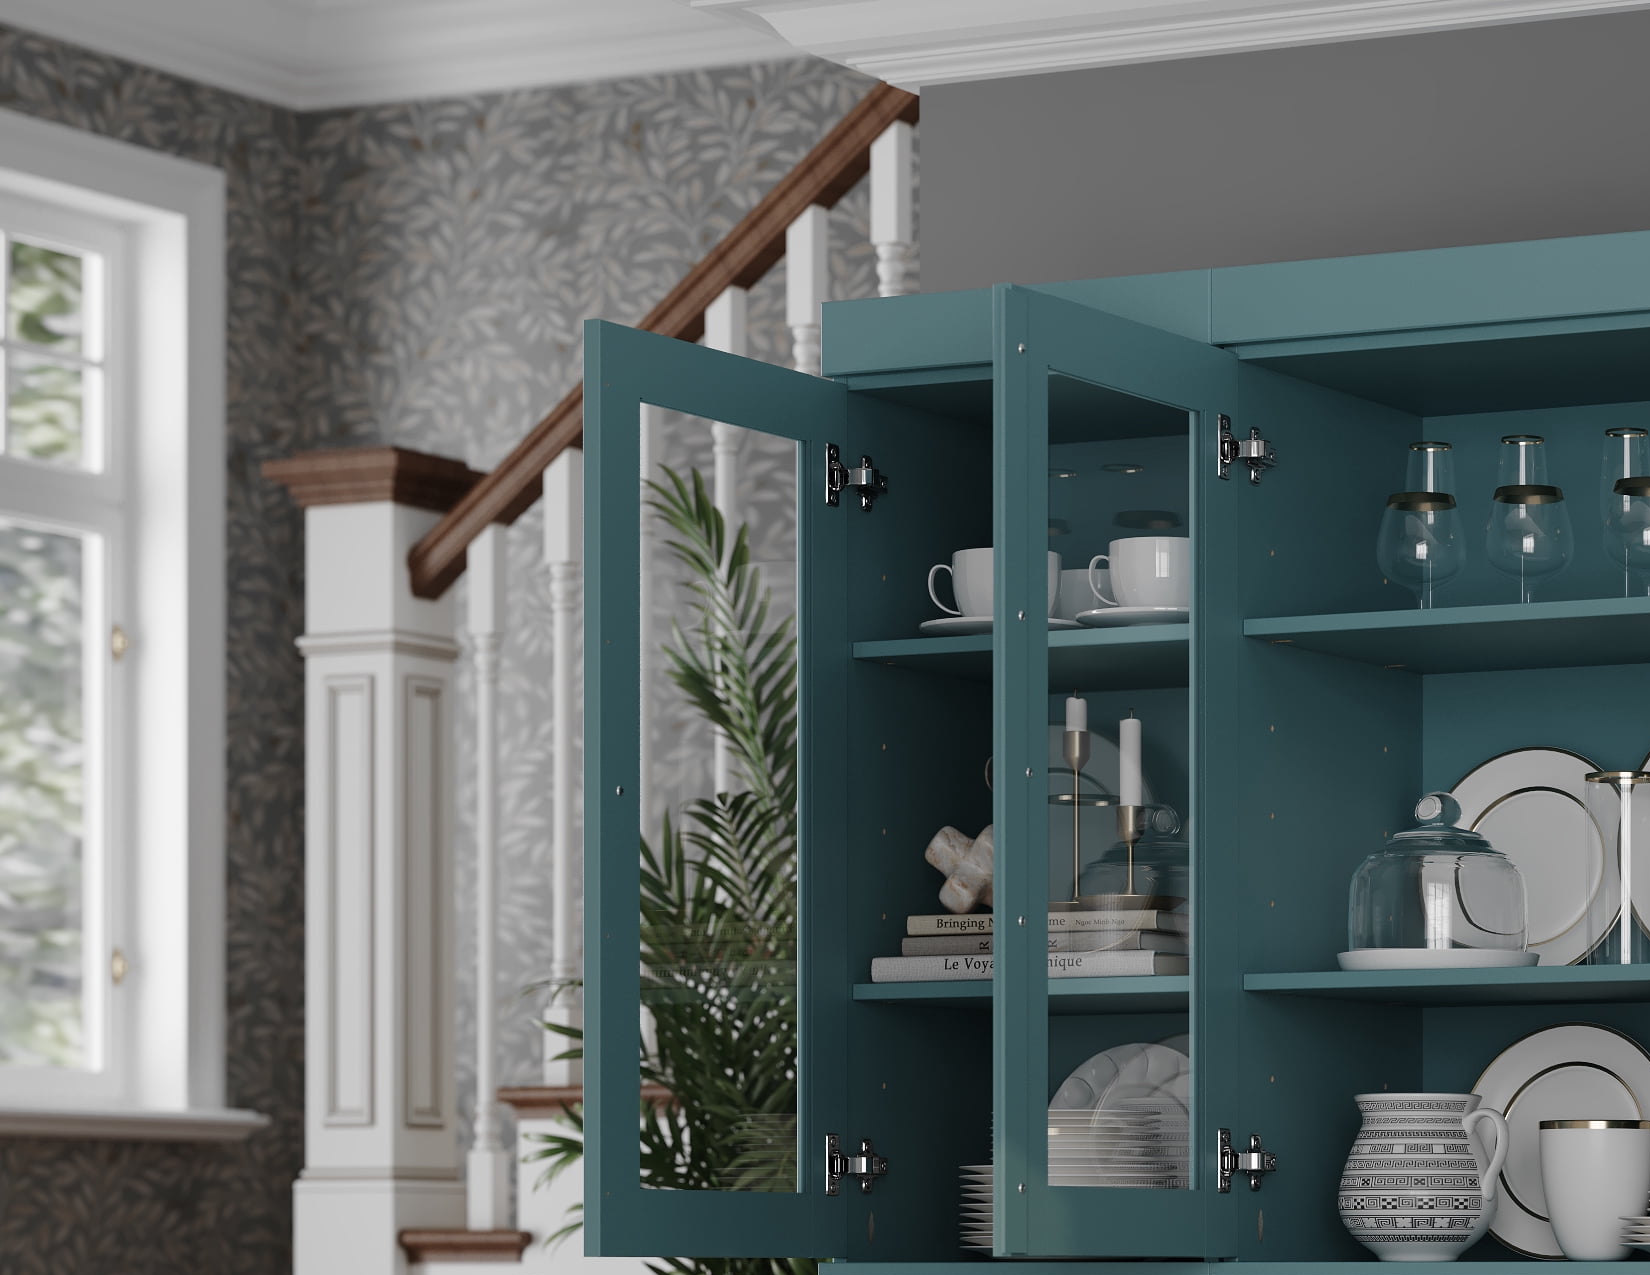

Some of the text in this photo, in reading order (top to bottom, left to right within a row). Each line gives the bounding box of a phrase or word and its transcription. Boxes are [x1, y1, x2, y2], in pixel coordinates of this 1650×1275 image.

[936, 918, 985, 931] Bringing
[1048, 918, 1066, 926] me
[944, 955, 1082, 973] Le Voya nique
